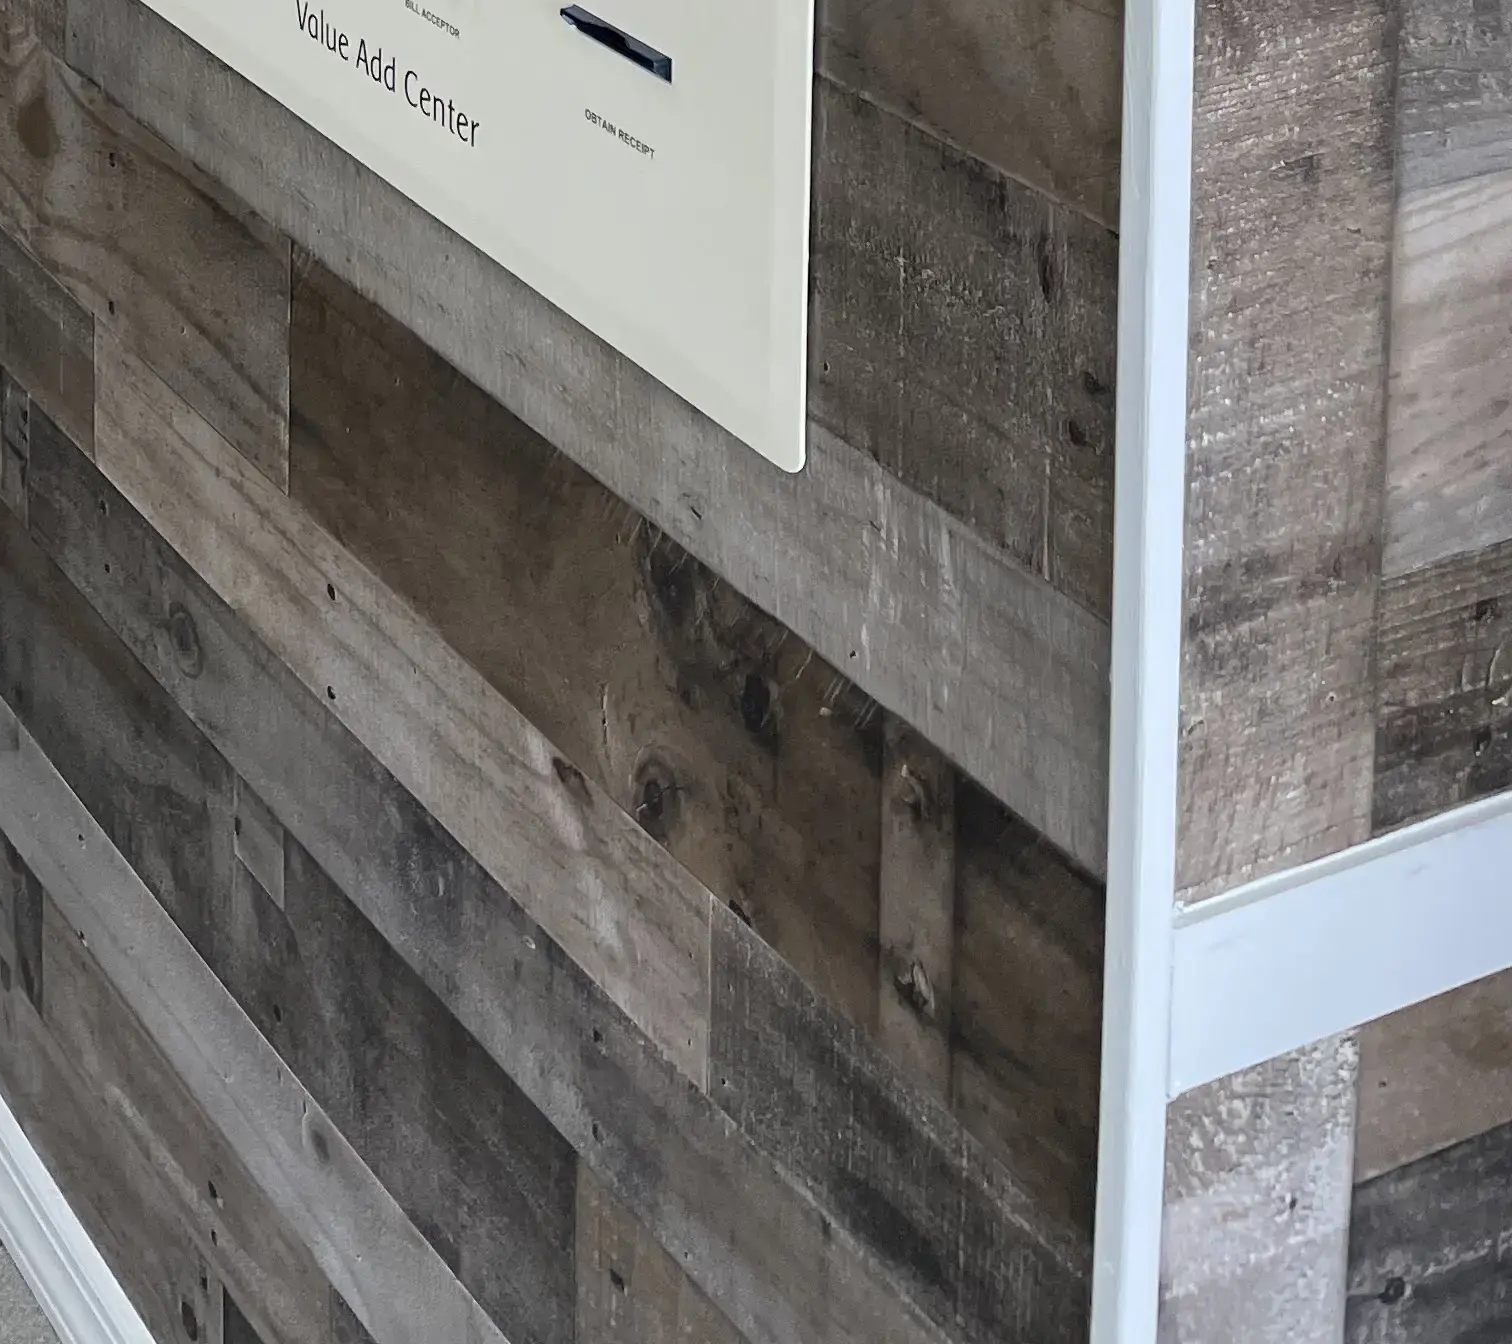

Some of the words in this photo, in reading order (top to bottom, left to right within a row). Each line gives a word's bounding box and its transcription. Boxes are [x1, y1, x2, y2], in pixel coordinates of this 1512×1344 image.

[421, 8, 461, 40] ACCEPTOR
[356, 38, 396, 93] Add
[404, 70, 480, 147] Center
[584, 108, 617, 137] OBTAIN
[618, 128, 655, 160] RECEIPT
